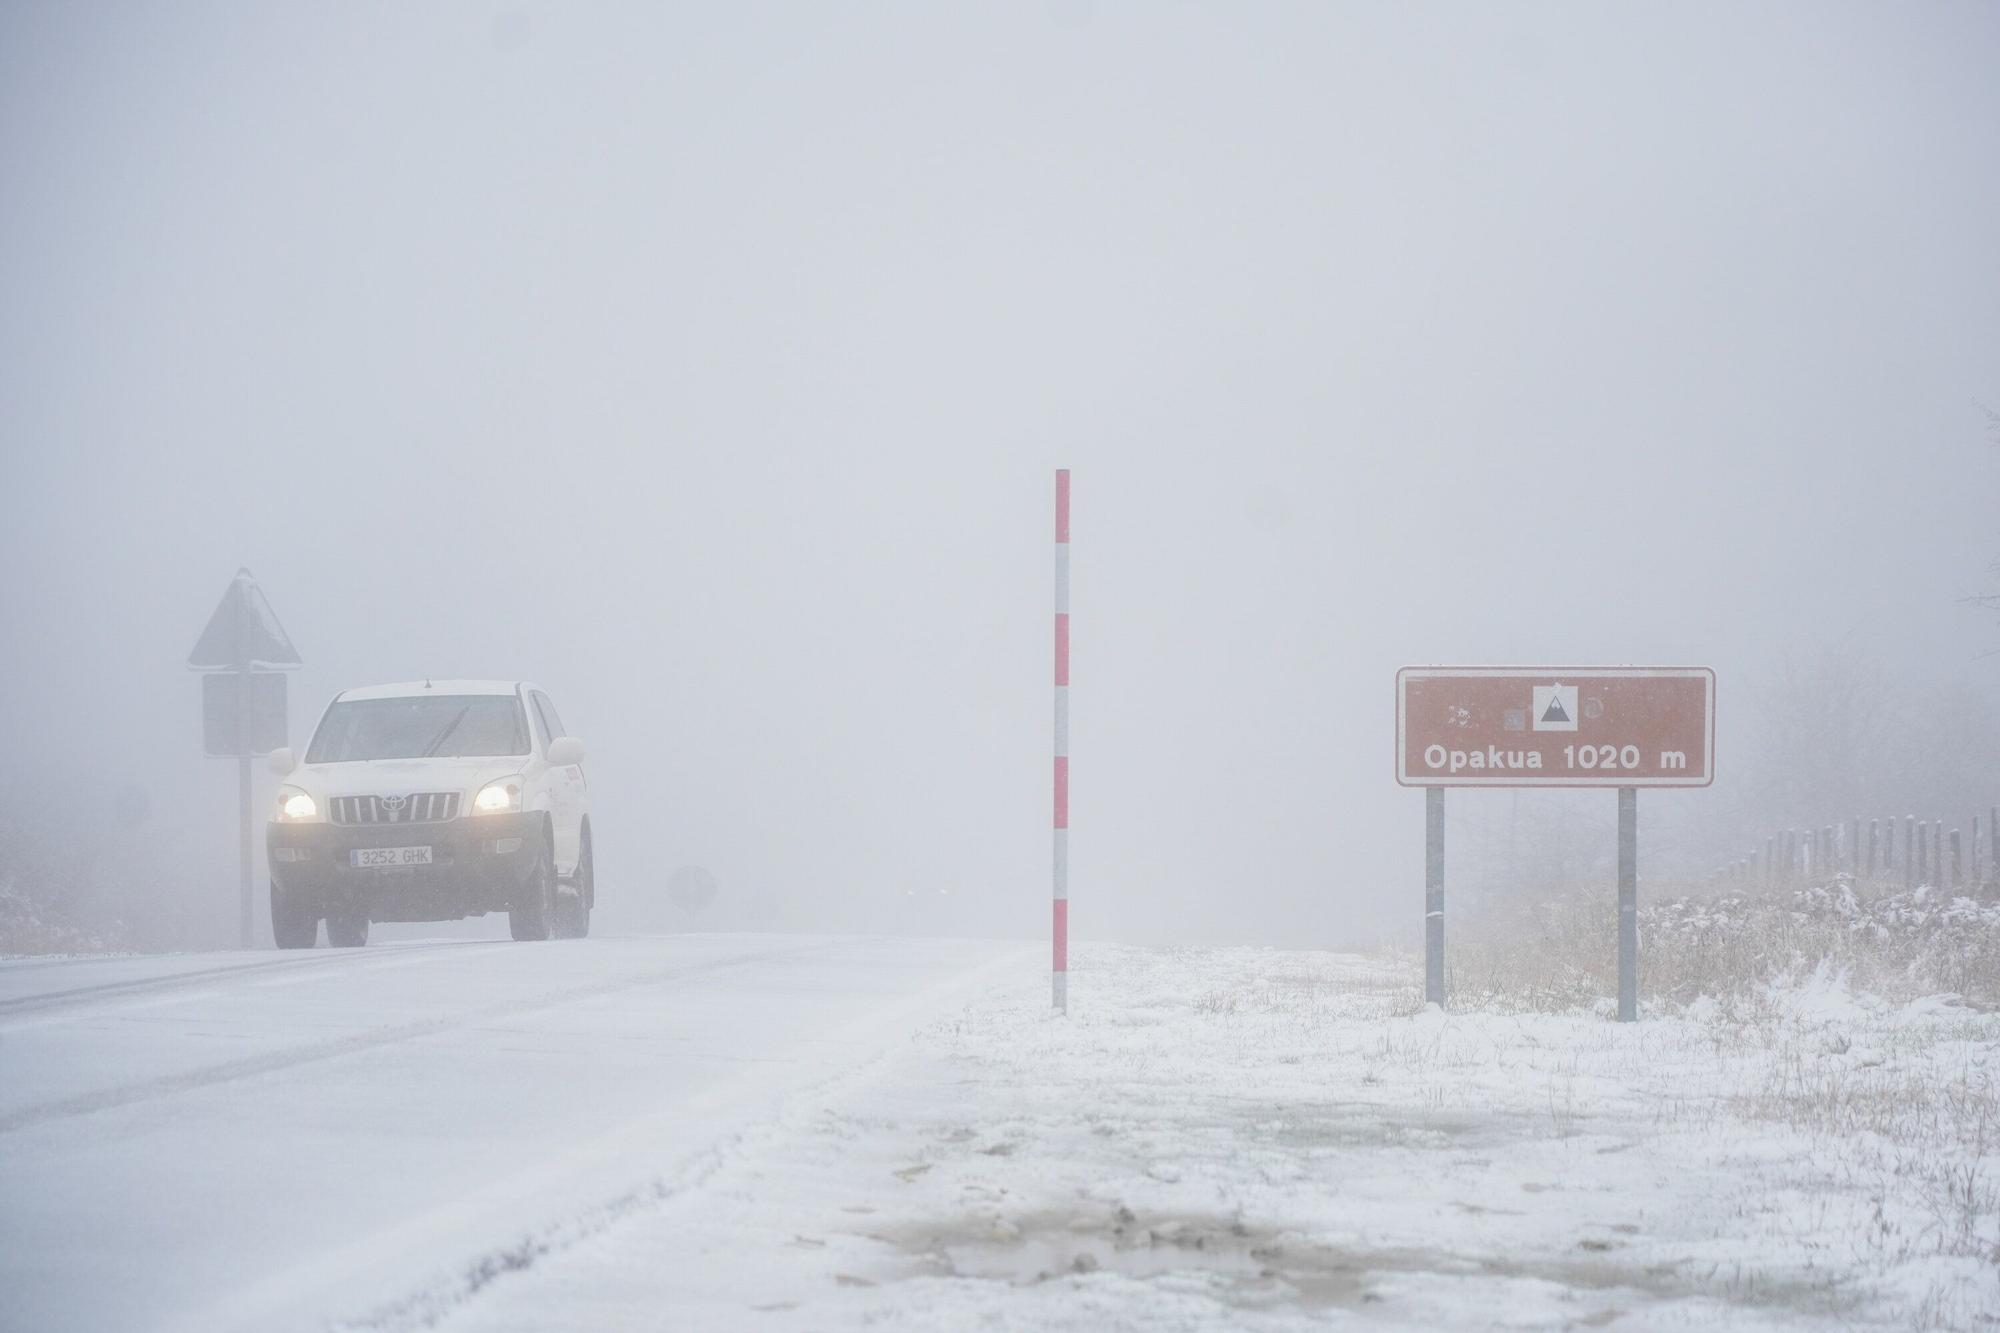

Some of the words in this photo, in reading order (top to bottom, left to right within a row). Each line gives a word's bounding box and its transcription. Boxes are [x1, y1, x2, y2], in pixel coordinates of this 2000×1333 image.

[1424, 744, 1542, 773] Opakua
[1564, 745, 1641, 769] 1020
[1660, 750, 1686, 769] m
[362, 850, 397, 865] 3252
[403, 848, 429, 863] GHK
